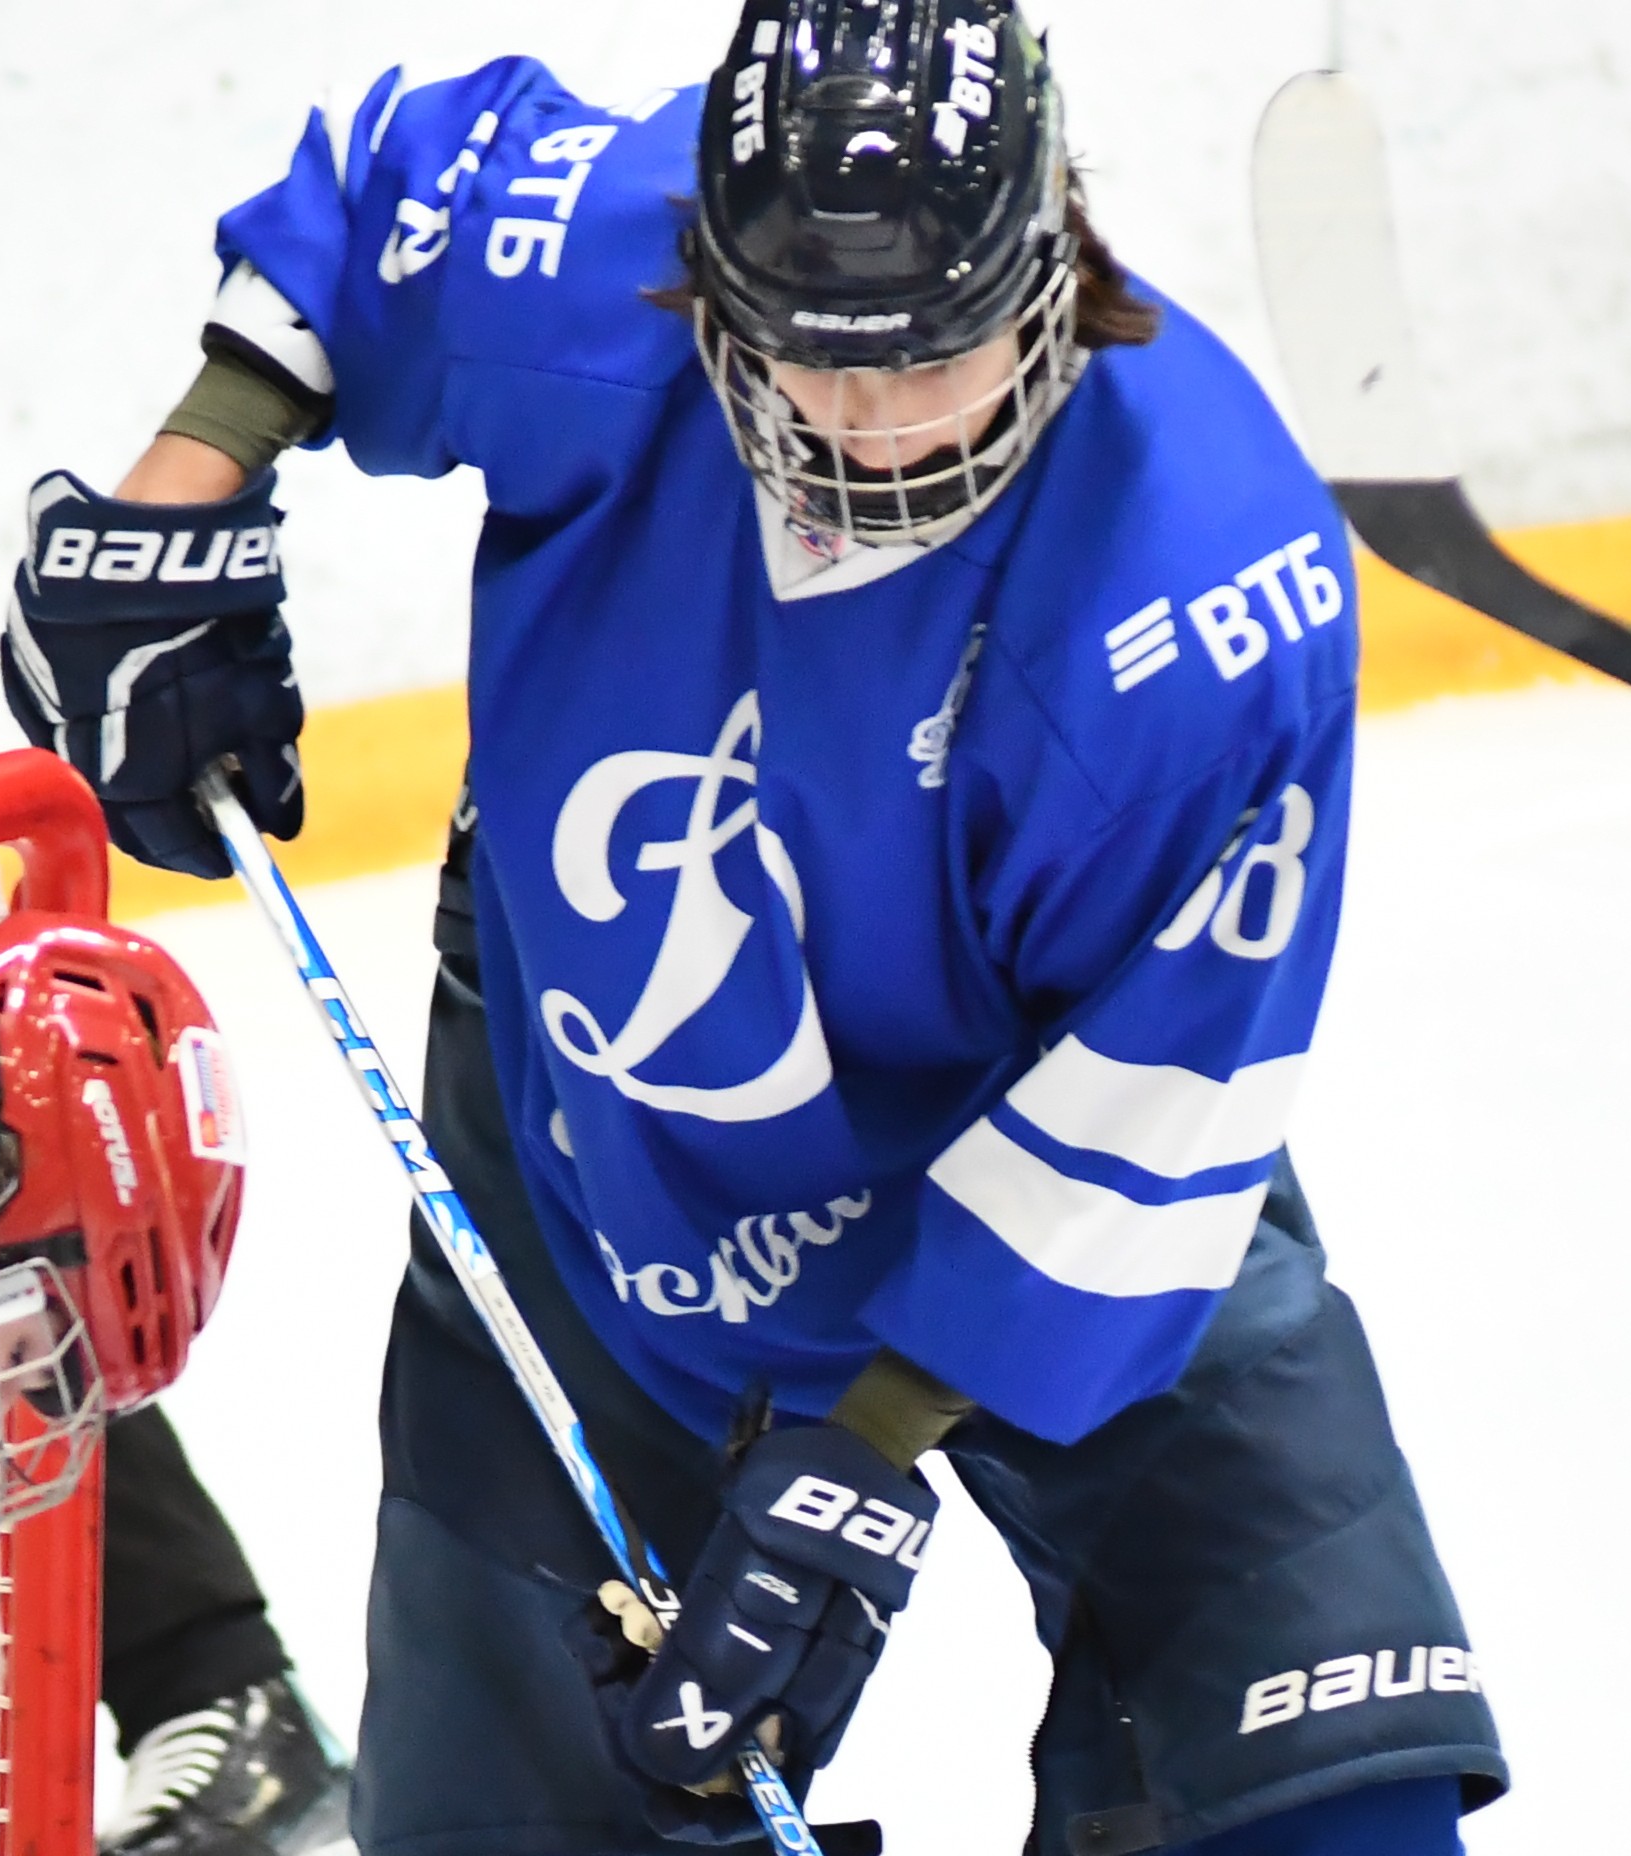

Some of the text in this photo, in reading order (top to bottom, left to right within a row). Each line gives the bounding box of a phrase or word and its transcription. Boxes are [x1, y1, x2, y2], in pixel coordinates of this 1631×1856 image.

[484, 124, 619, 279] ВТБ
[1186, 530, 1344, 682] ВТБ
[301, 975, 455, 1195] CCM
